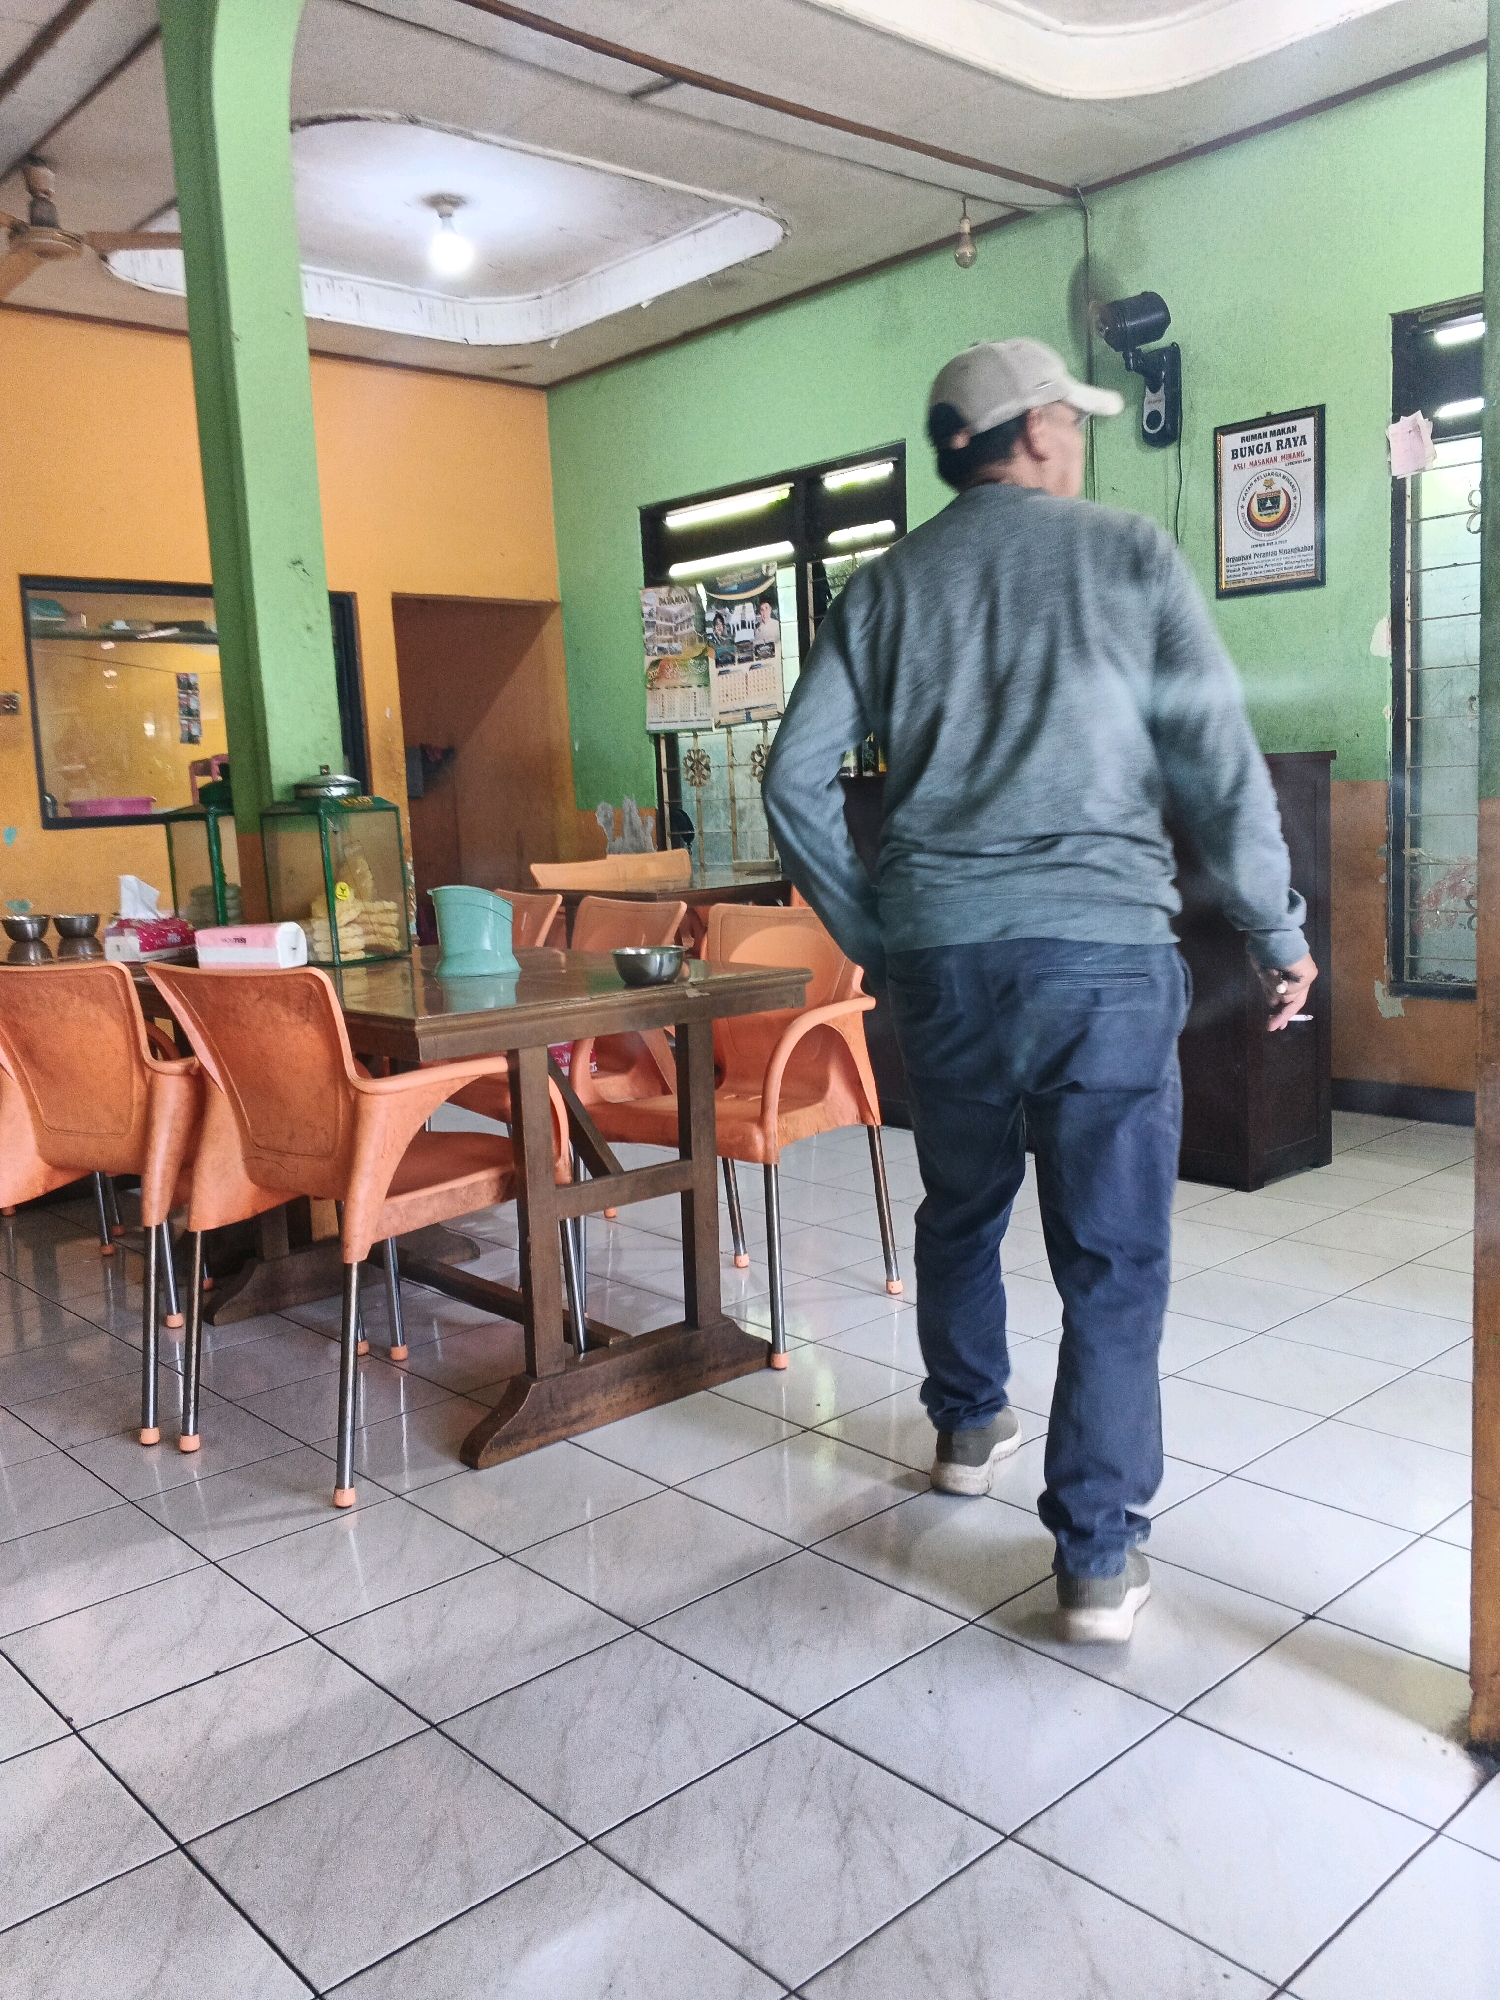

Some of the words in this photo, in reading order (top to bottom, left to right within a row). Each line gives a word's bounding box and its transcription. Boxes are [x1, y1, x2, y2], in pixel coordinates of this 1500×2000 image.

[1240, 430, 1268, 443] RUMAH
[1269, 425, 1297, 438] MAKAN
[1230, 441, 1272, 460] BUNGA
[1276, 434, 1307, 451] RAYA
[1233, 462, 1246, 471] ASLI
[1248, 456, 1278, 467] MASAKAN
[1280, 450, 1305, 461] MINANG
[1254, 471, 1282, 483] KELUARGA
[1282, 474, 1297, 493] MINANG
